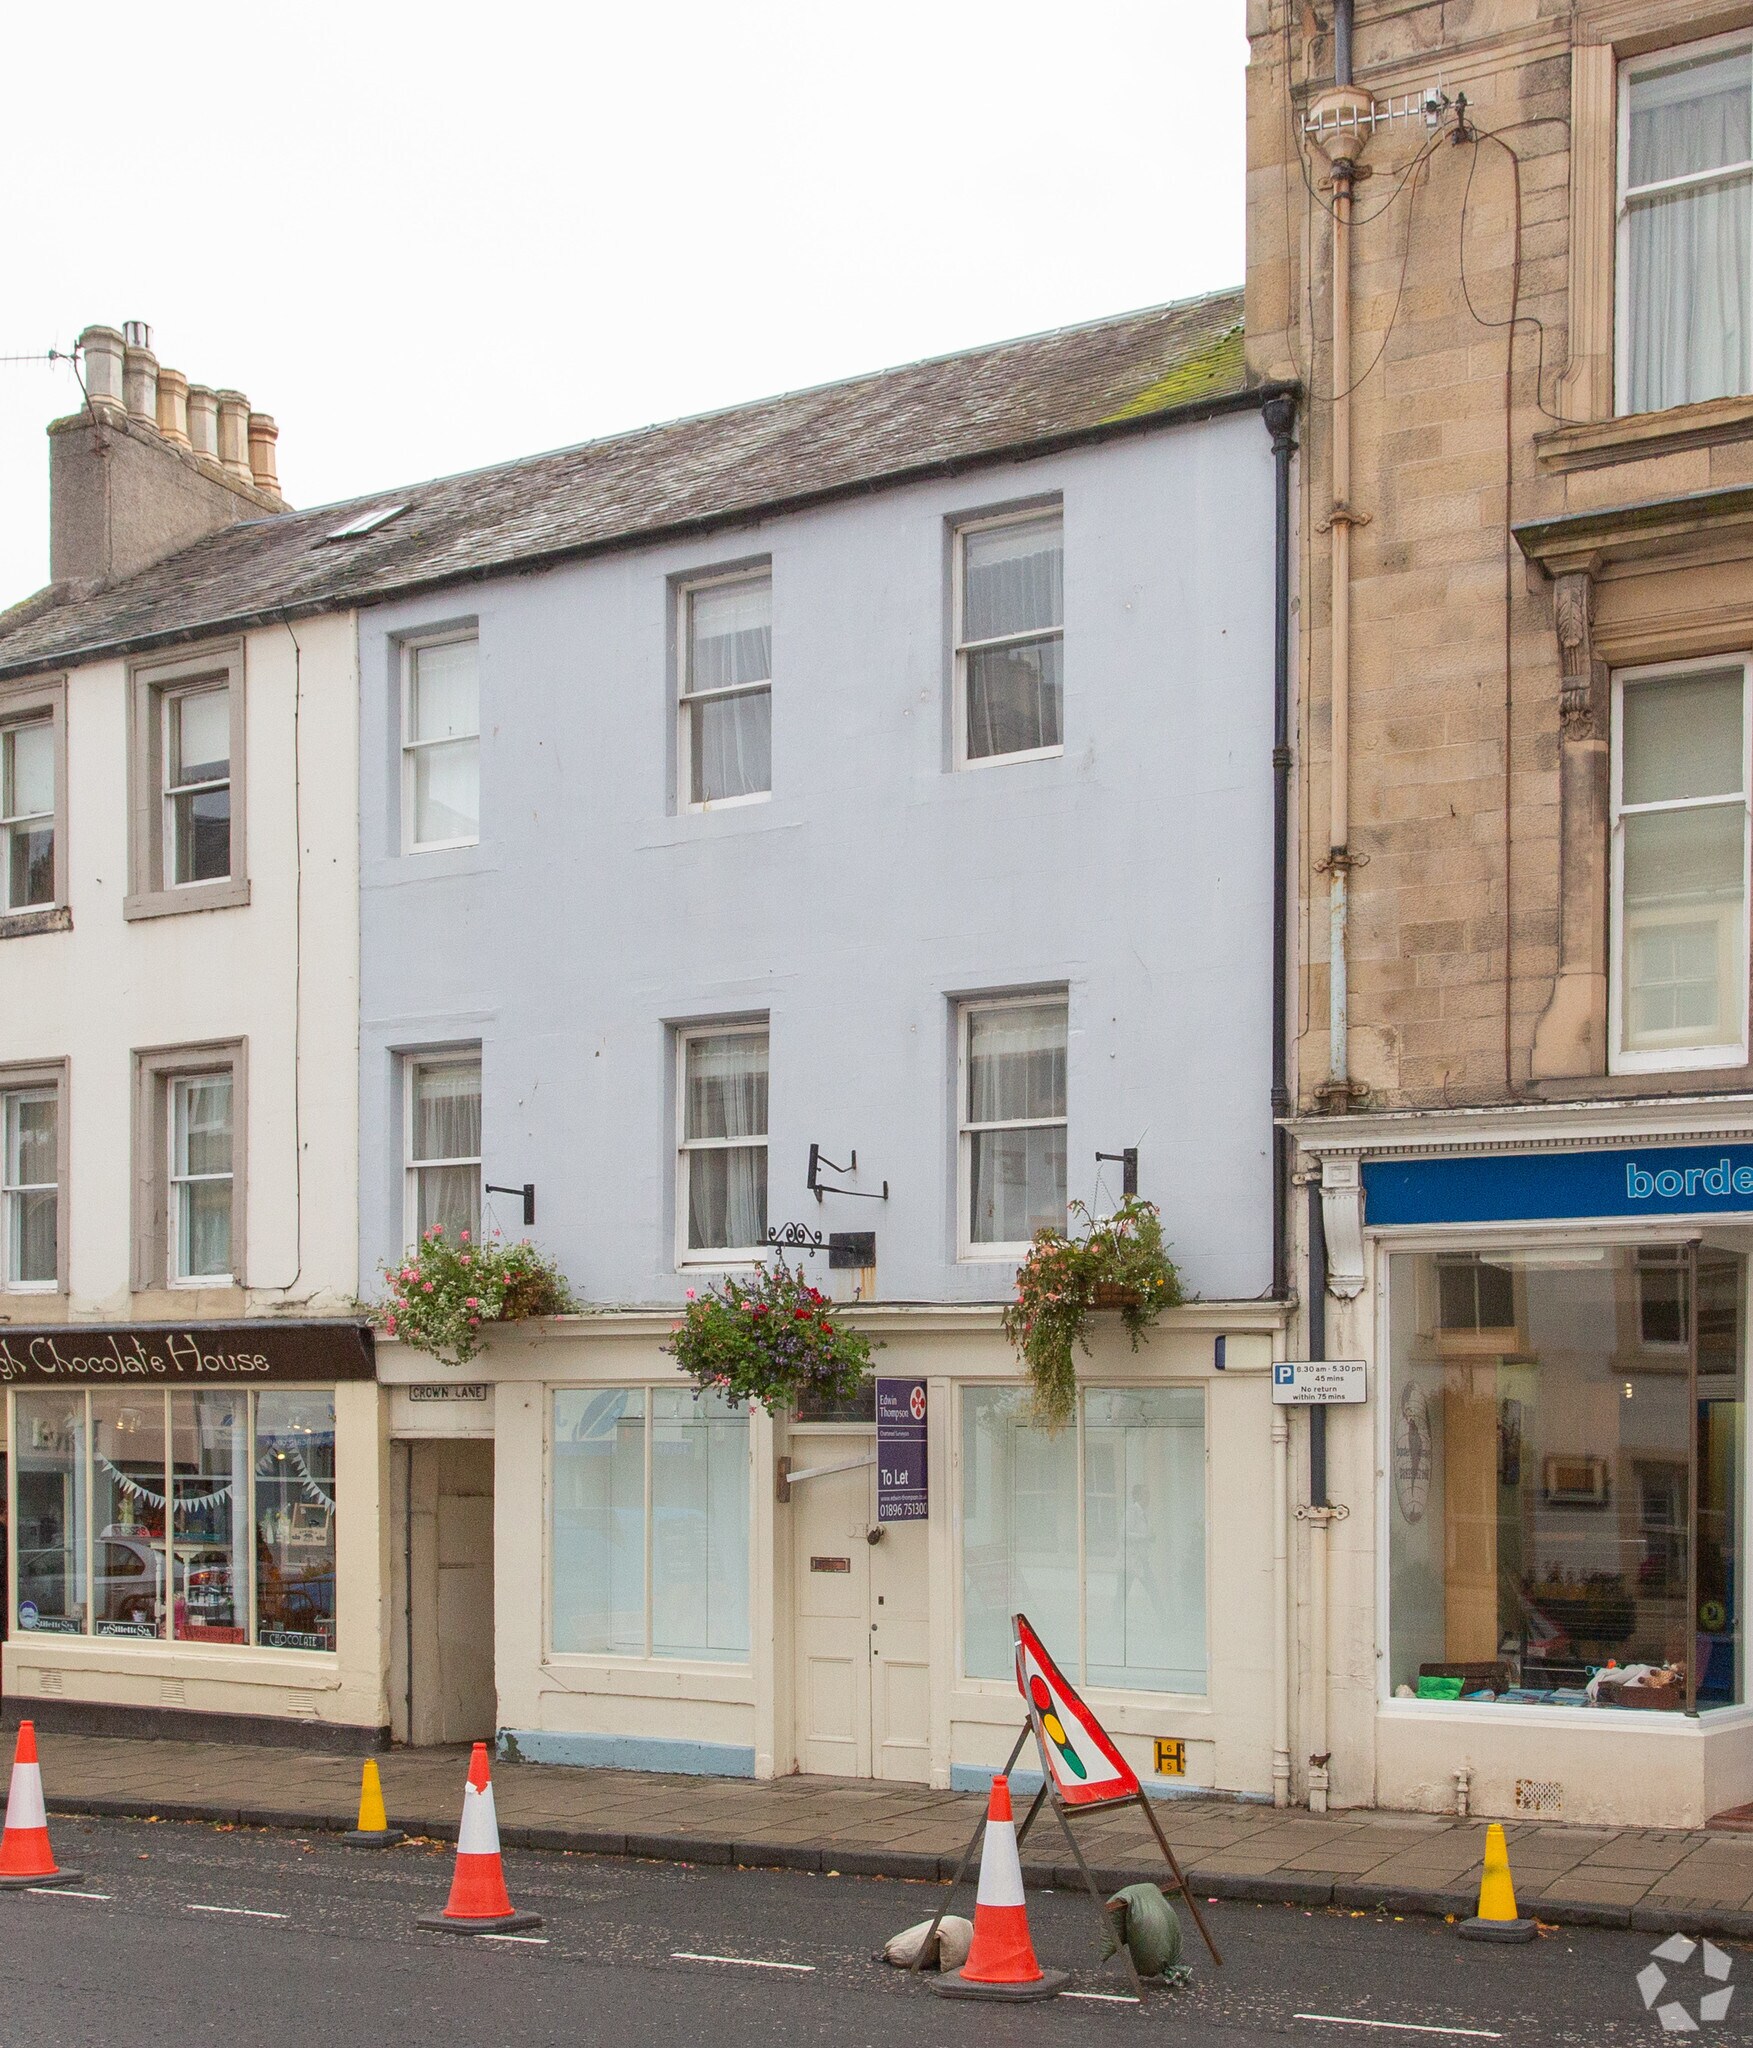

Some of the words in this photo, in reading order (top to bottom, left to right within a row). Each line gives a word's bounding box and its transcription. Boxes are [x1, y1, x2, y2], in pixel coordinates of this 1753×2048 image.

[1626, 1158, 1753, 1198] borde
[29, 1335, 166, 1374] Chocolate
[166, 1335, 270, 1372] House
[1280, 1367, 1291, 1383] P
[413, 1386, 448, 1398] CROWN
[455, 1386, 482, 1398] LANE
[880, 1394, 897, 1405] Edwin
[879, 1406, 909, 1421] Thompson
[881, 1469, 892, 1485] To
[894, 1469, 909, 1485] Let
[880, 1503, 903, 1517] 01896
[903, 1502, 927, 1516] 751300
[269, 1633, 317, 1647] CHOCOLATE
[1158, 1742, 1181, 1772] H
[1167, 1762, 1172, 1770] 5
